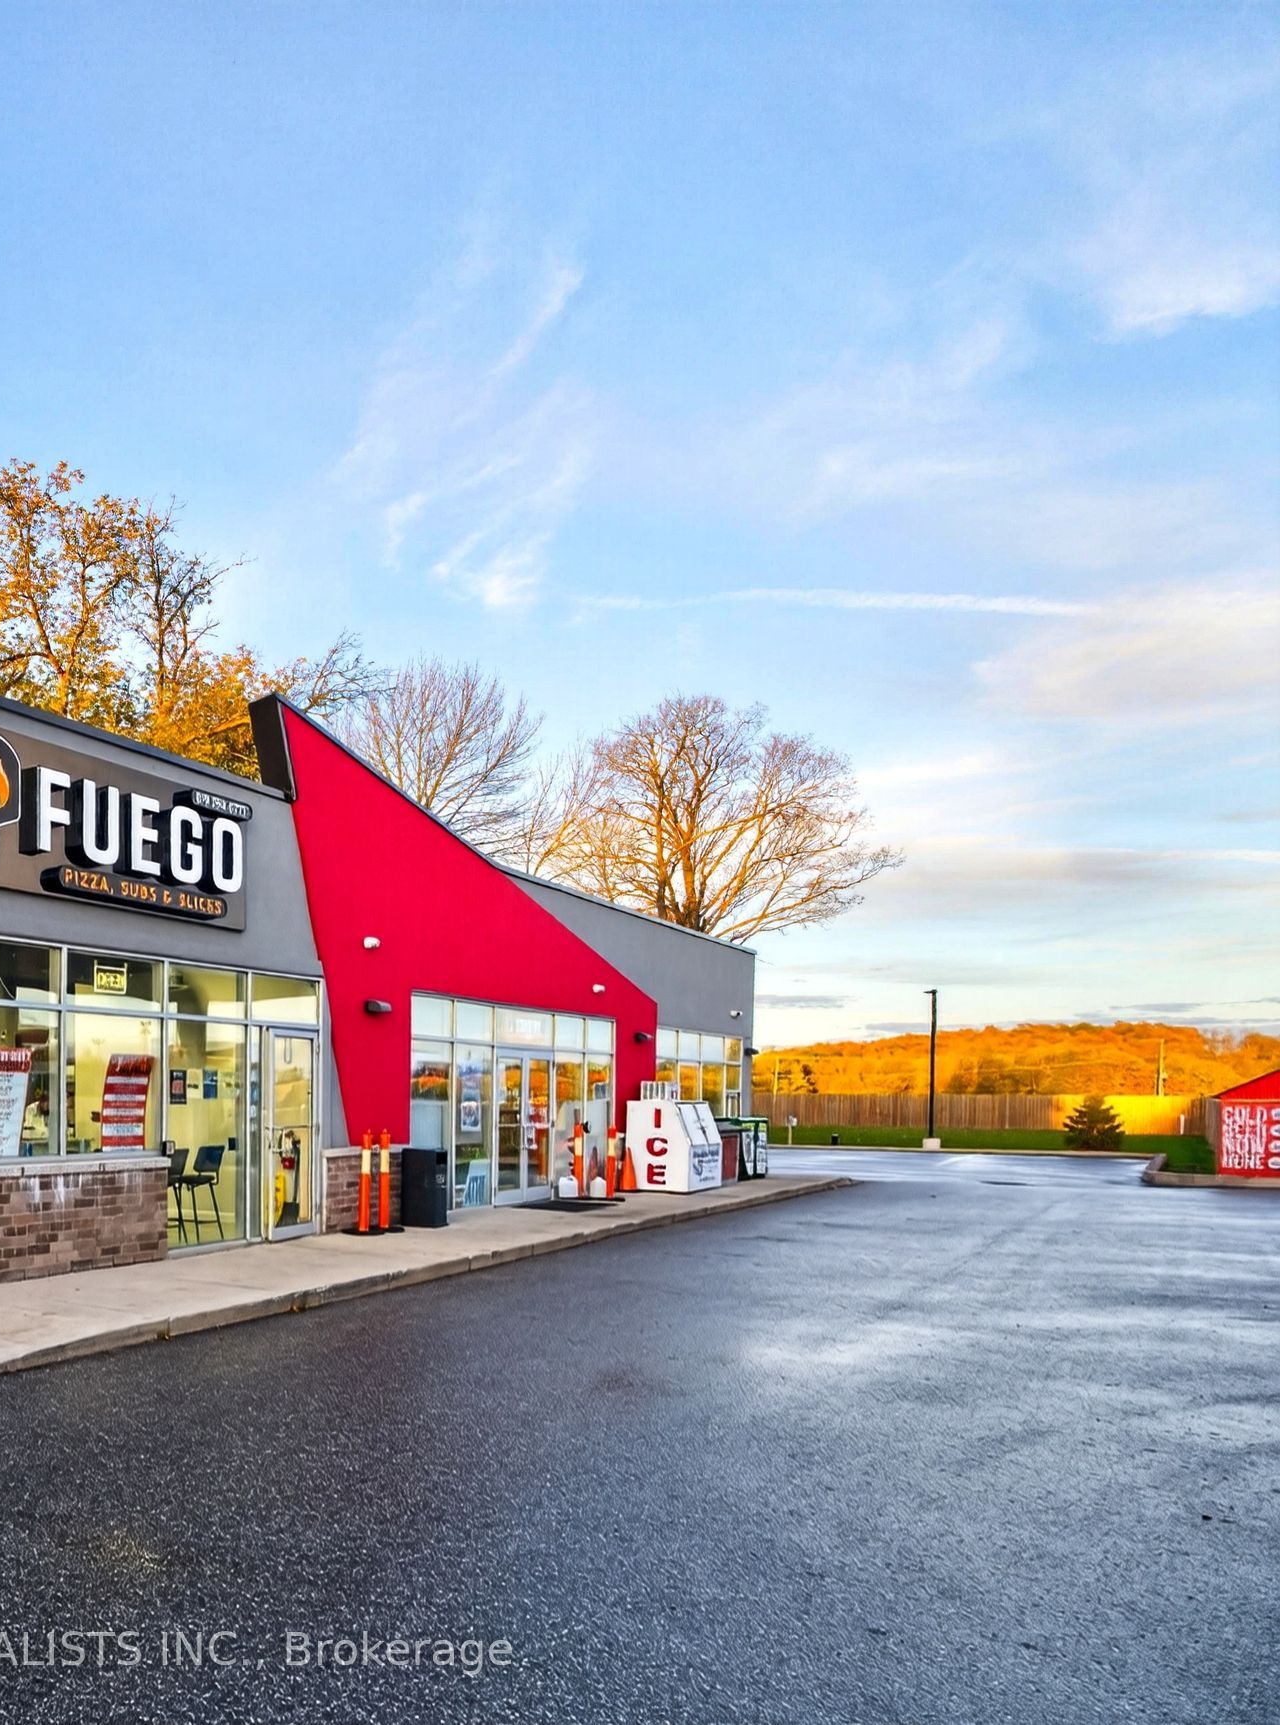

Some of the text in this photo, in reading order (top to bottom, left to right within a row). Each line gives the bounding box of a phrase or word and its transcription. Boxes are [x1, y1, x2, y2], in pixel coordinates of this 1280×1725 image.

[37, 766, 243, 893] FUEGO
[64, 869, 114, 896] PIZZA,
[120, 881, 157, 902] SUBS
[179, 893, 222, 915] SLICES
[646, 1107, 668, 1185] ICE
